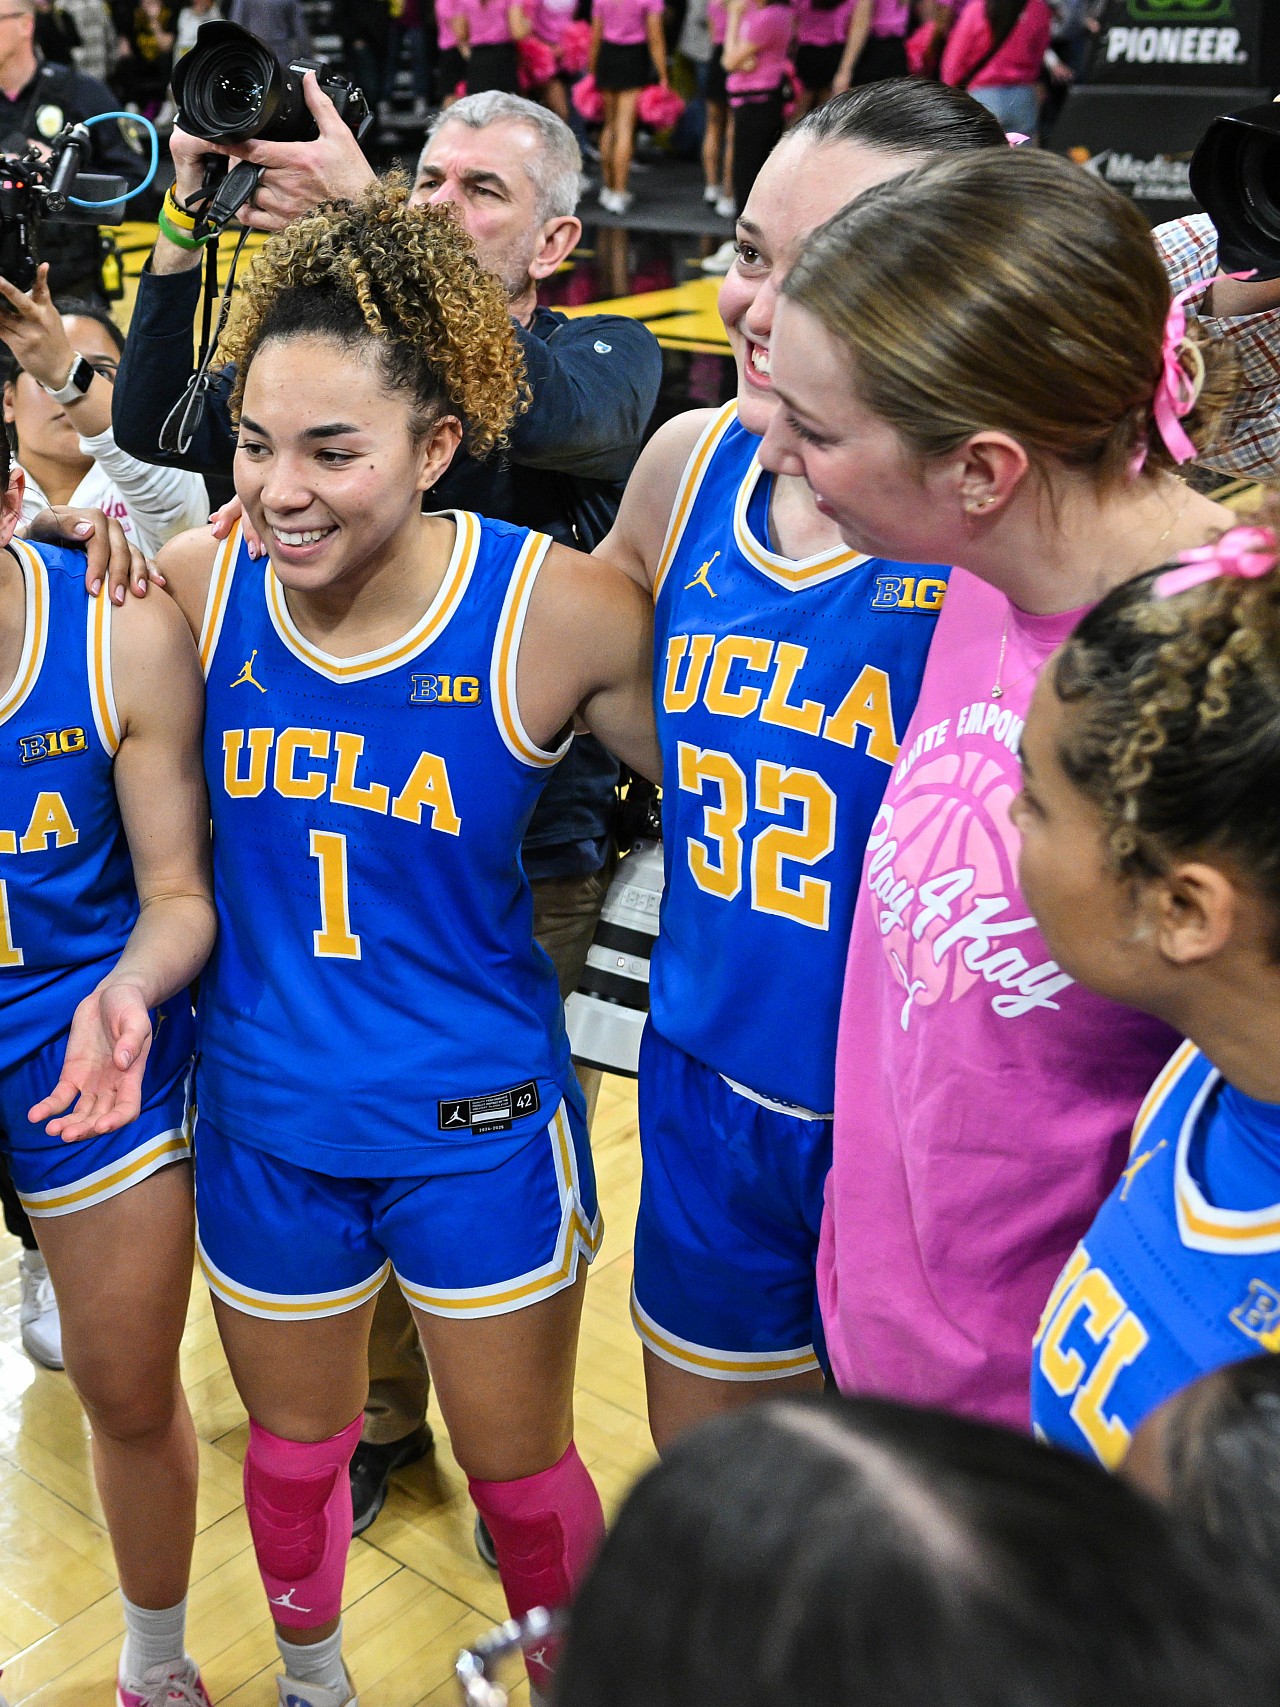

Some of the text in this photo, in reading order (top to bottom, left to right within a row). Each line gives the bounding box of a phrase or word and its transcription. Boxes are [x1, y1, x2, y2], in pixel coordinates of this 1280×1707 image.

[662, 633, 902, 767] UCLA
[956, 701, 1025, 764] EMPOW
[222, 726, 462, 837] UCLA
[677, 740, 838, 932] 32
[309, 828, 362, 961] 1
[516, 1093, 533, 1109] 42
